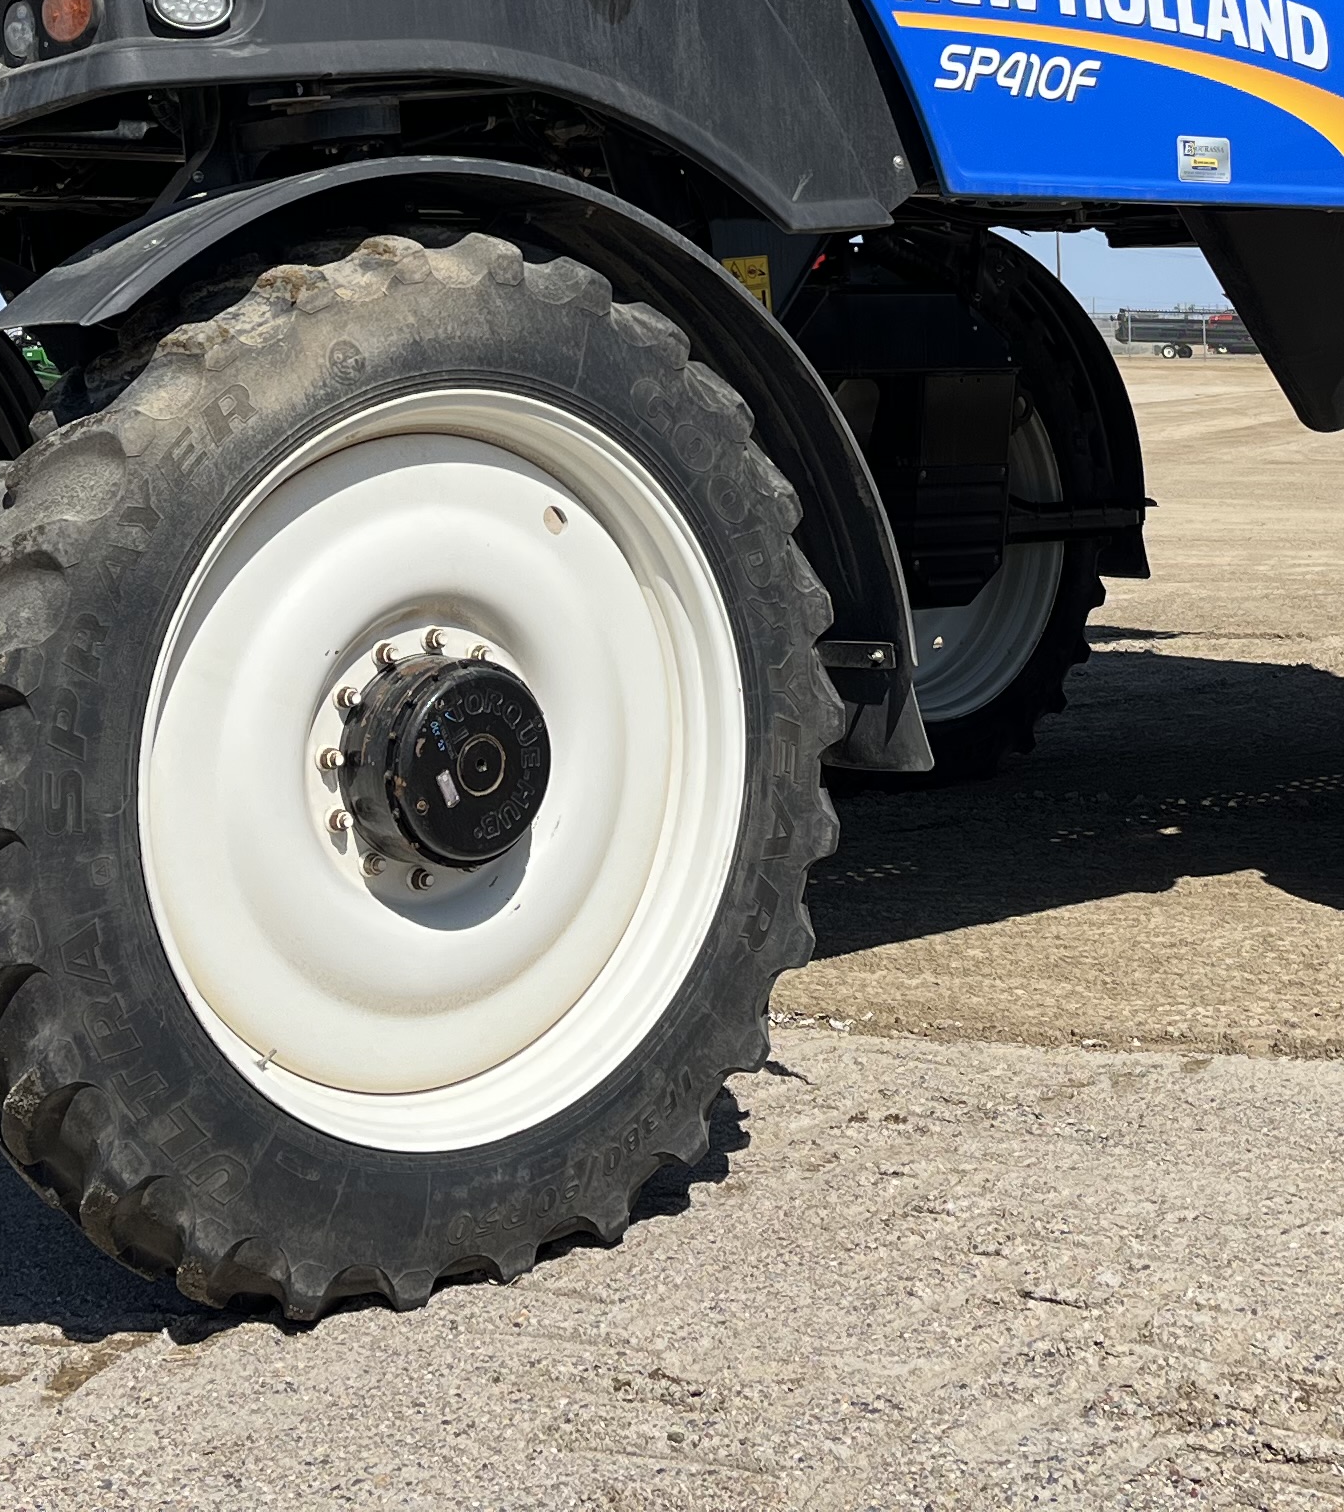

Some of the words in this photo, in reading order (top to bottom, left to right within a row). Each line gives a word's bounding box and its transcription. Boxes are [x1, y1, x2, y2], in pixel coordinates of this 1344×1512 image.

[933, 44, 1102, 102] SP410F
[42, 383, 258, 838] SPRAYER
[630, 377, 803, 952] GOODYEAR
[60, 918, 250, 1207] ULTRA
